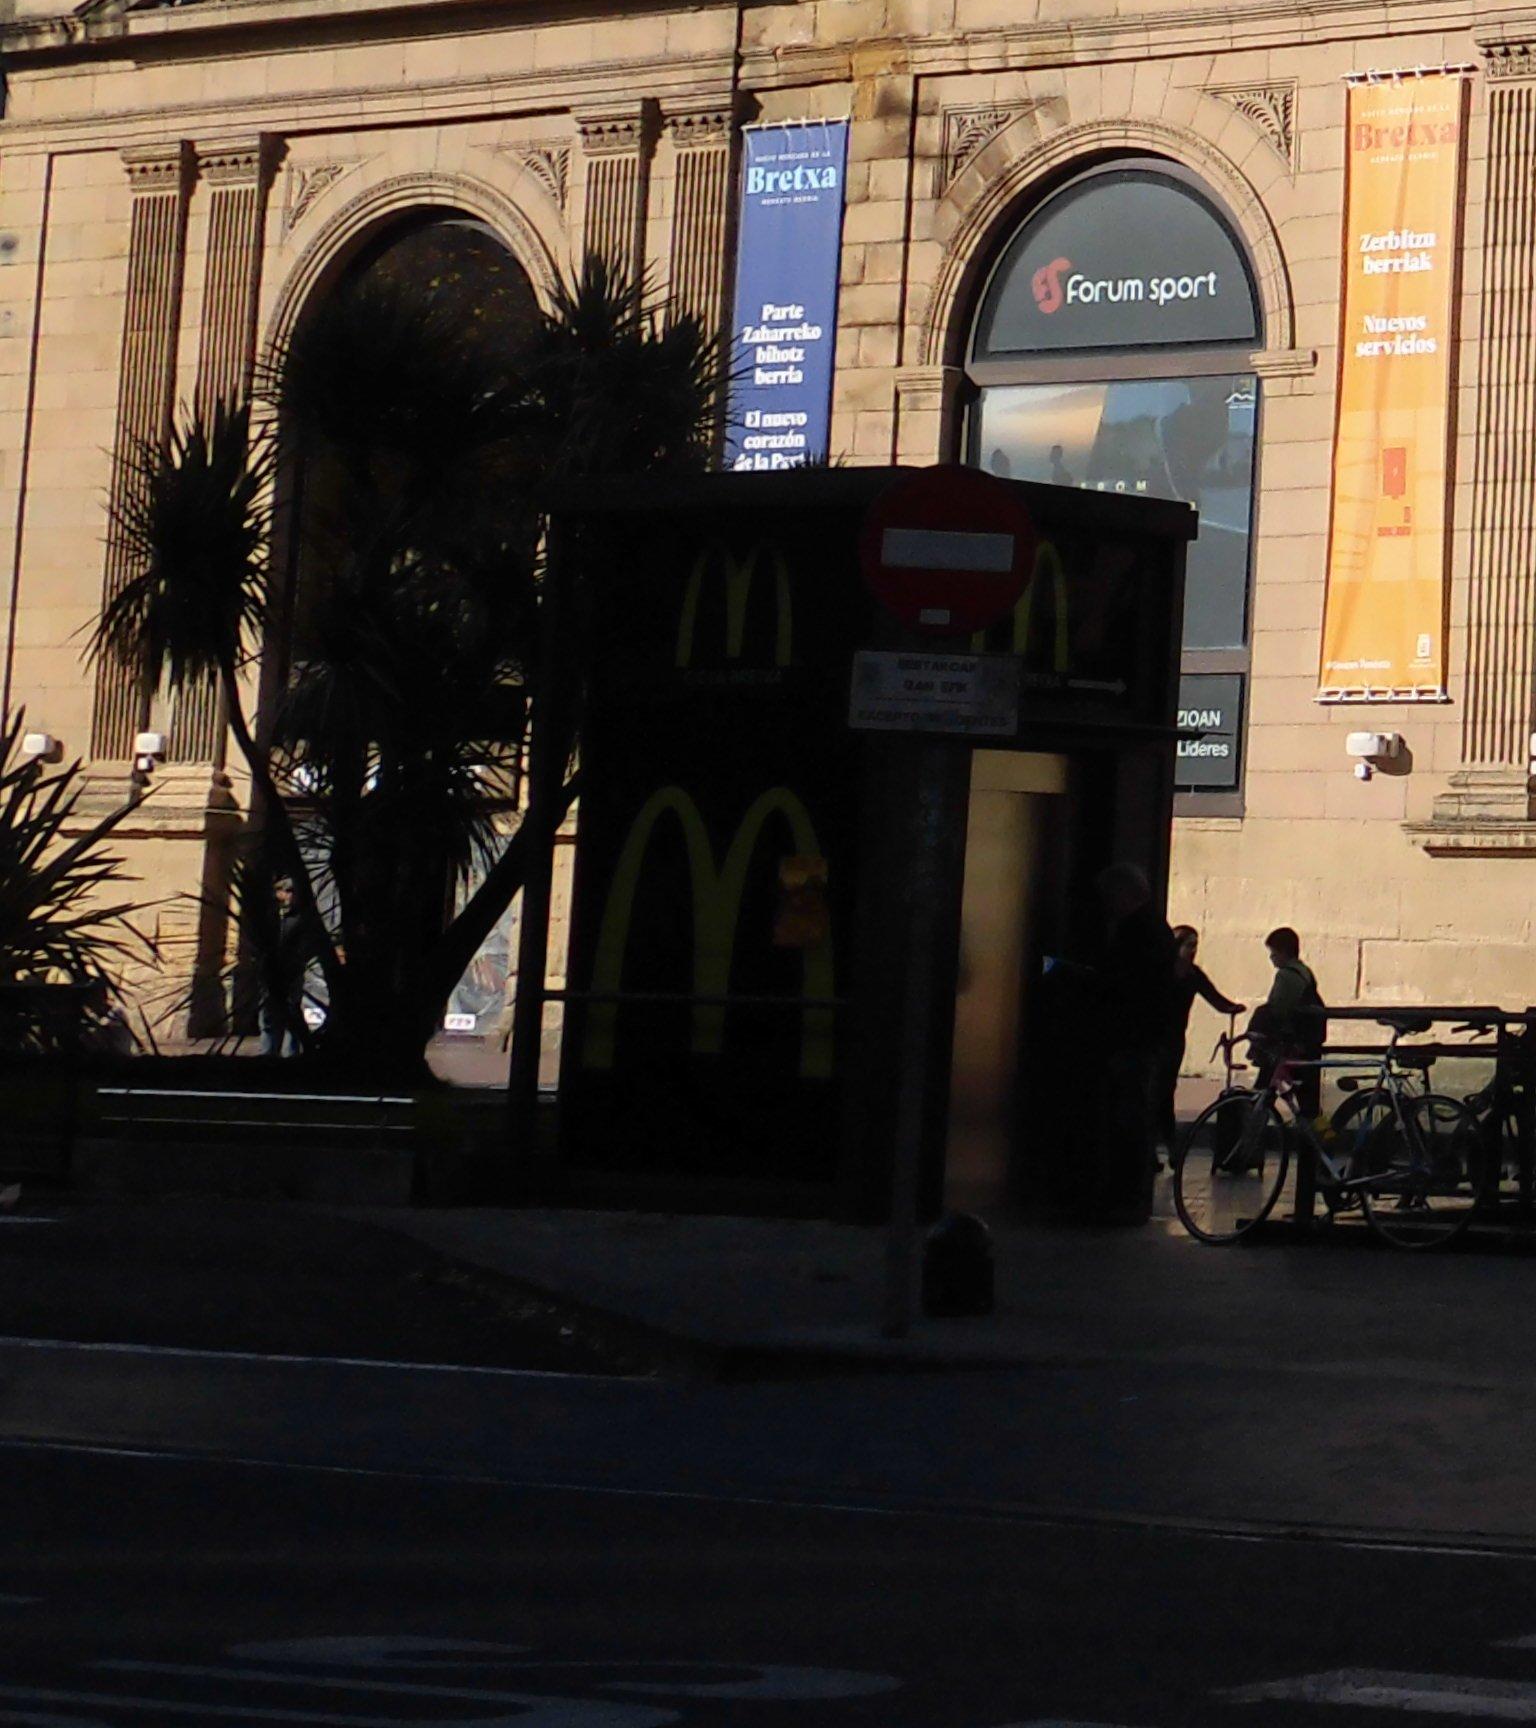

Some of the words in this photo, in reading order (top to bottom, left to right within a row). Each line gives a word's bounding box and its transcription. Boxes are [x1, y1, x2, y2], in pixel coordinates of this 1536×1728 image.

[1354, 122, 1460, 151] Bretxa
[746, 164, 837, 194] Bretxa
[1360, 229, 1437, 252] Zerbitzu
[1363, 251, 1433, 275] berriak
[1066, 273, 1143, 304] forum
[1148, 271, 1217, 306] sport
[762, 304, 804, 322] Parte
[1362, 314, 1427, 333] Nuevos
[742, 322, 822, 343] Zaharreko
[755, 343, 806, 364] bihotz
[1355, 333, 1438, 358] servicios
[754, 363, 804, 386] berria
[762, 411, 808, 427] nuevo
[743, 429, 806, 450] corazón
